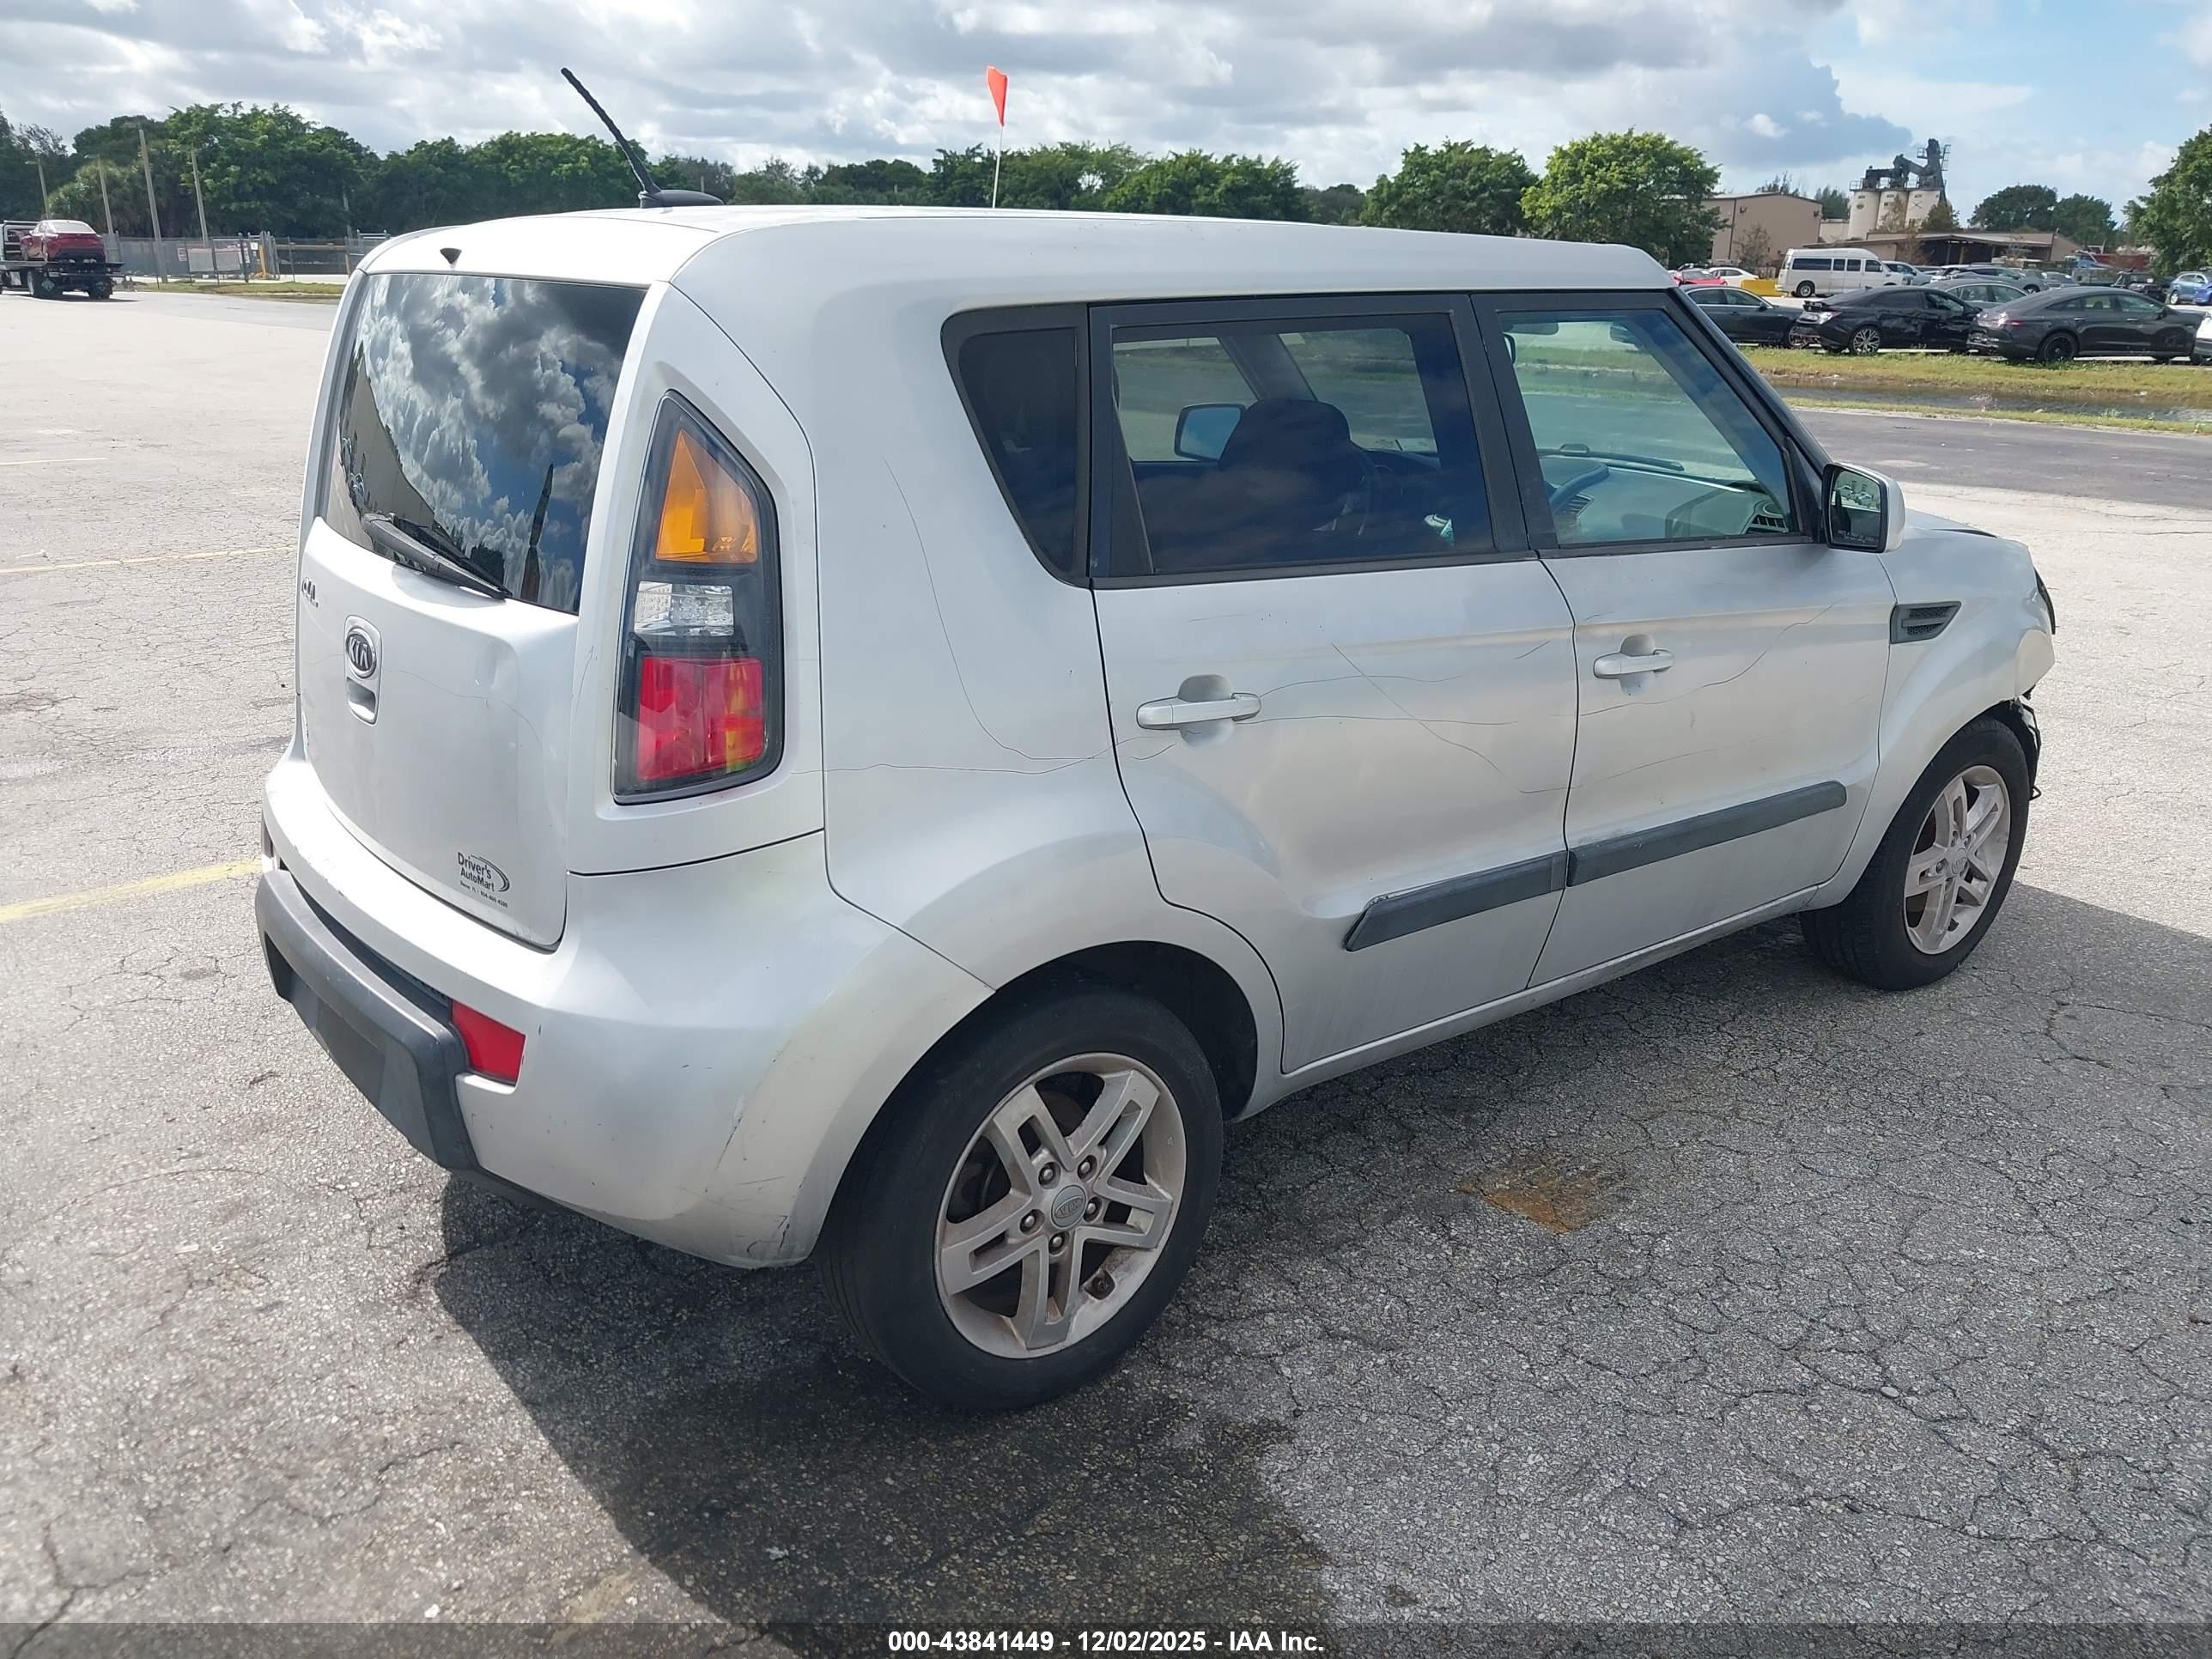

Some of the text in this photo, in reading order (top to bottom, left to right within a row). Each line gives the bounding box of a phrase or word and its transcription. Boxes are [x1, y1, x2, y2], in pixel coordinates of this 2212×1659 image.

[349, 635, 369, 670] KIA
[458, 851, 492, 880] Driver's
[460, 866, 495, 892] AutoMart
